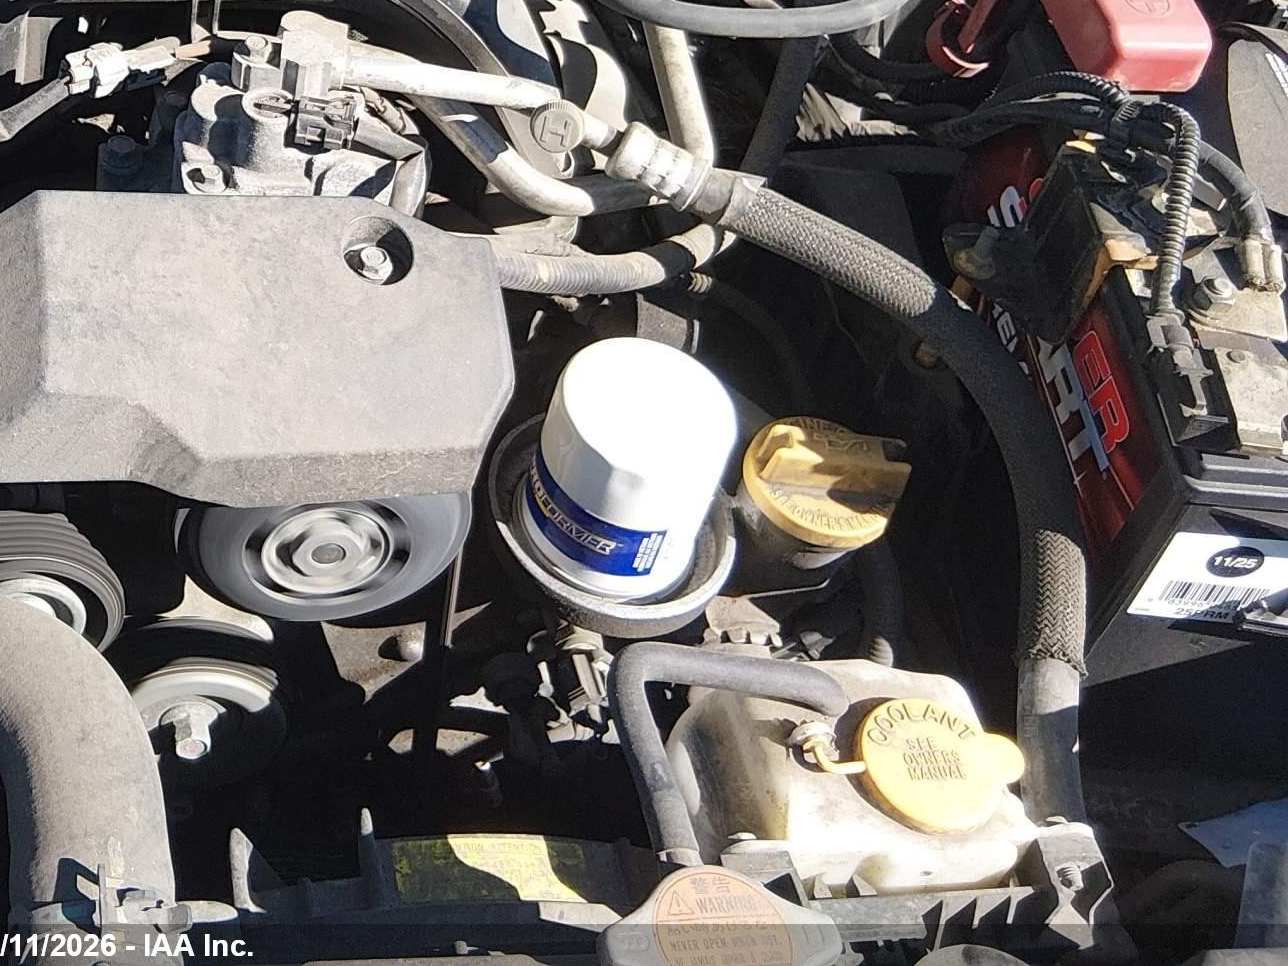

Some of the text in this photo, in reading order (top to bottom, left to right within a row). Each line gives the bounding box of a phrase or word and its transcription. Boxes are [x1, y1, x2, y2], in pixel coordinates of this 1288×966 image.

[1213, 555, 1257, 569] 11/25
[866, 702, 976, 745] COOLANT
[905, 736, 936, 751] SEE
[902, 748, 961, 767] OWNERS
[907, 764, 967, 781] MANUAL
[694, 894, 758, 915] WARNING
